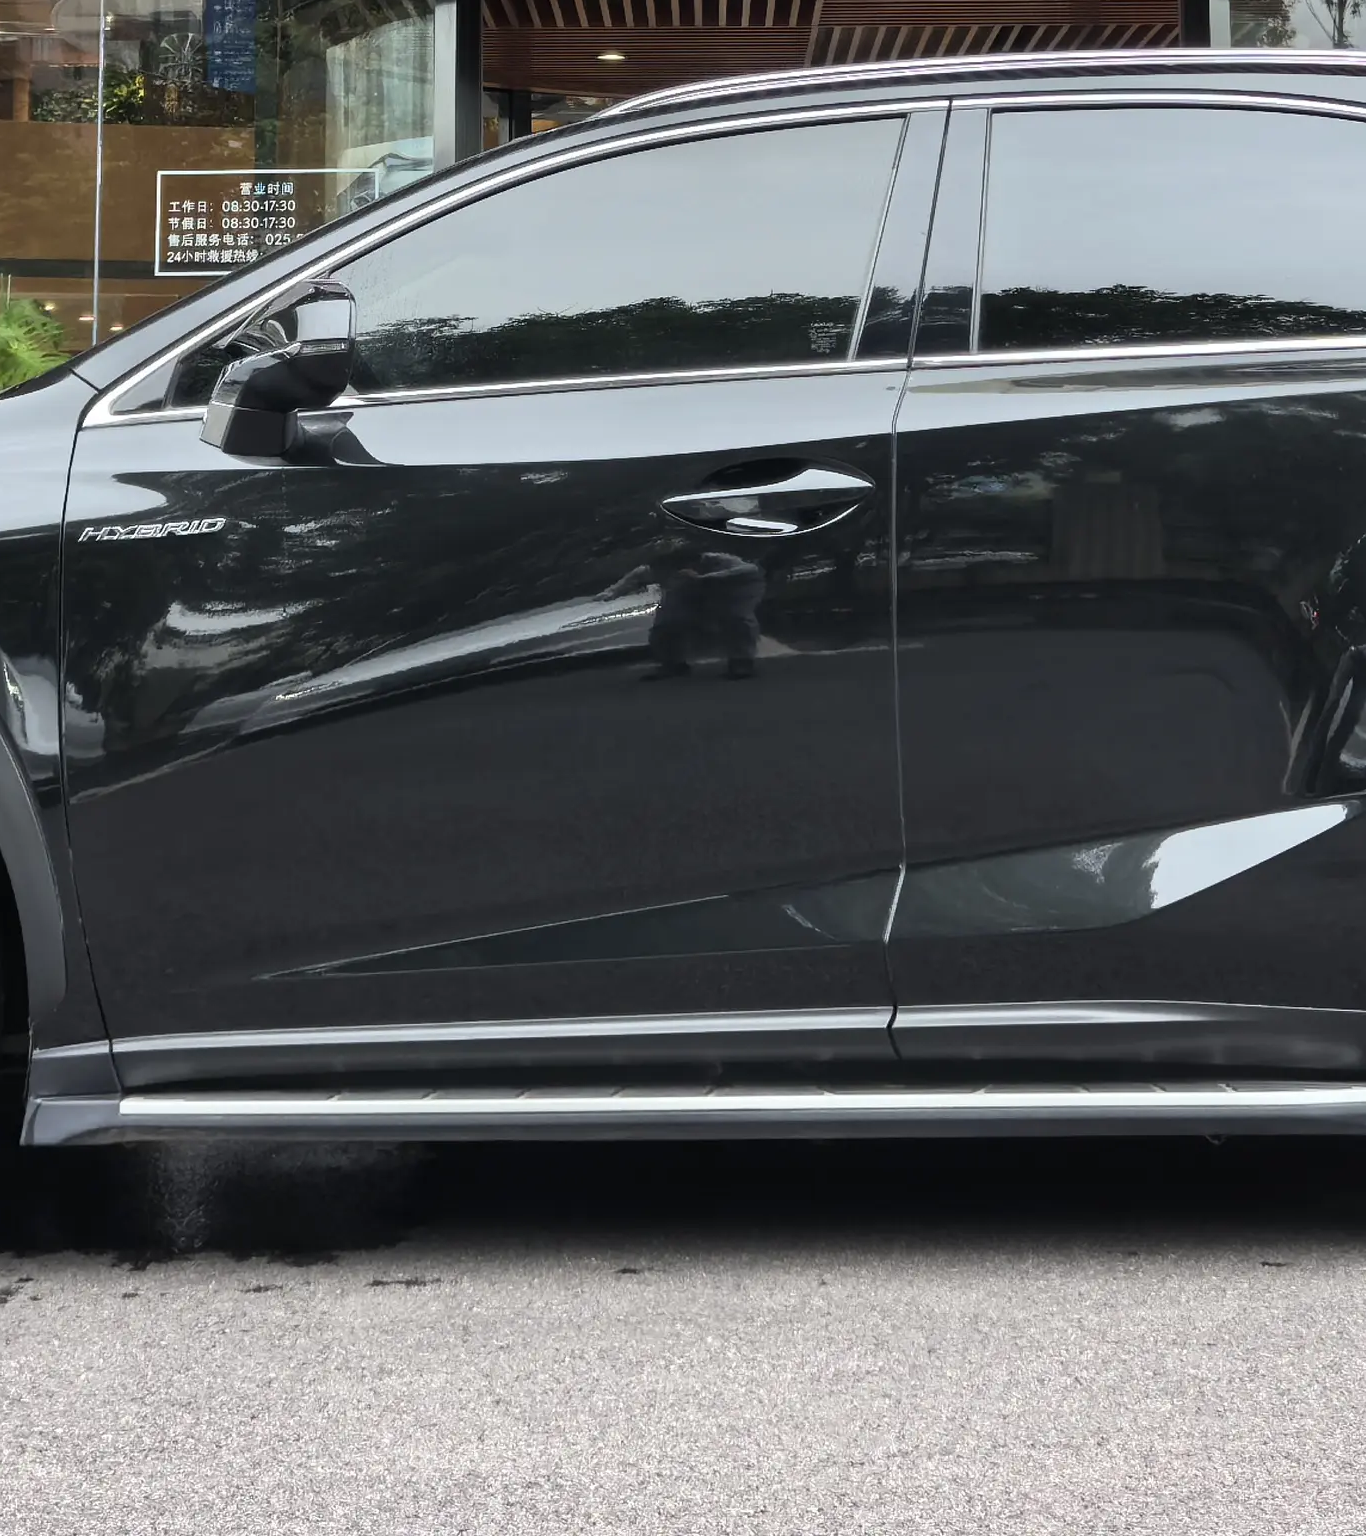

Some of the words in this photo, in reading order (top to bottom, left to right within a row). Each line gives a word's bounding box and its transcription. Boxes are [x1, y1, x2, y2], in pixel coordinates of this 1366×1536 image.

[239, 182, 294, 195] 营业时间
[77, 517, 227, 543] HYBRID
